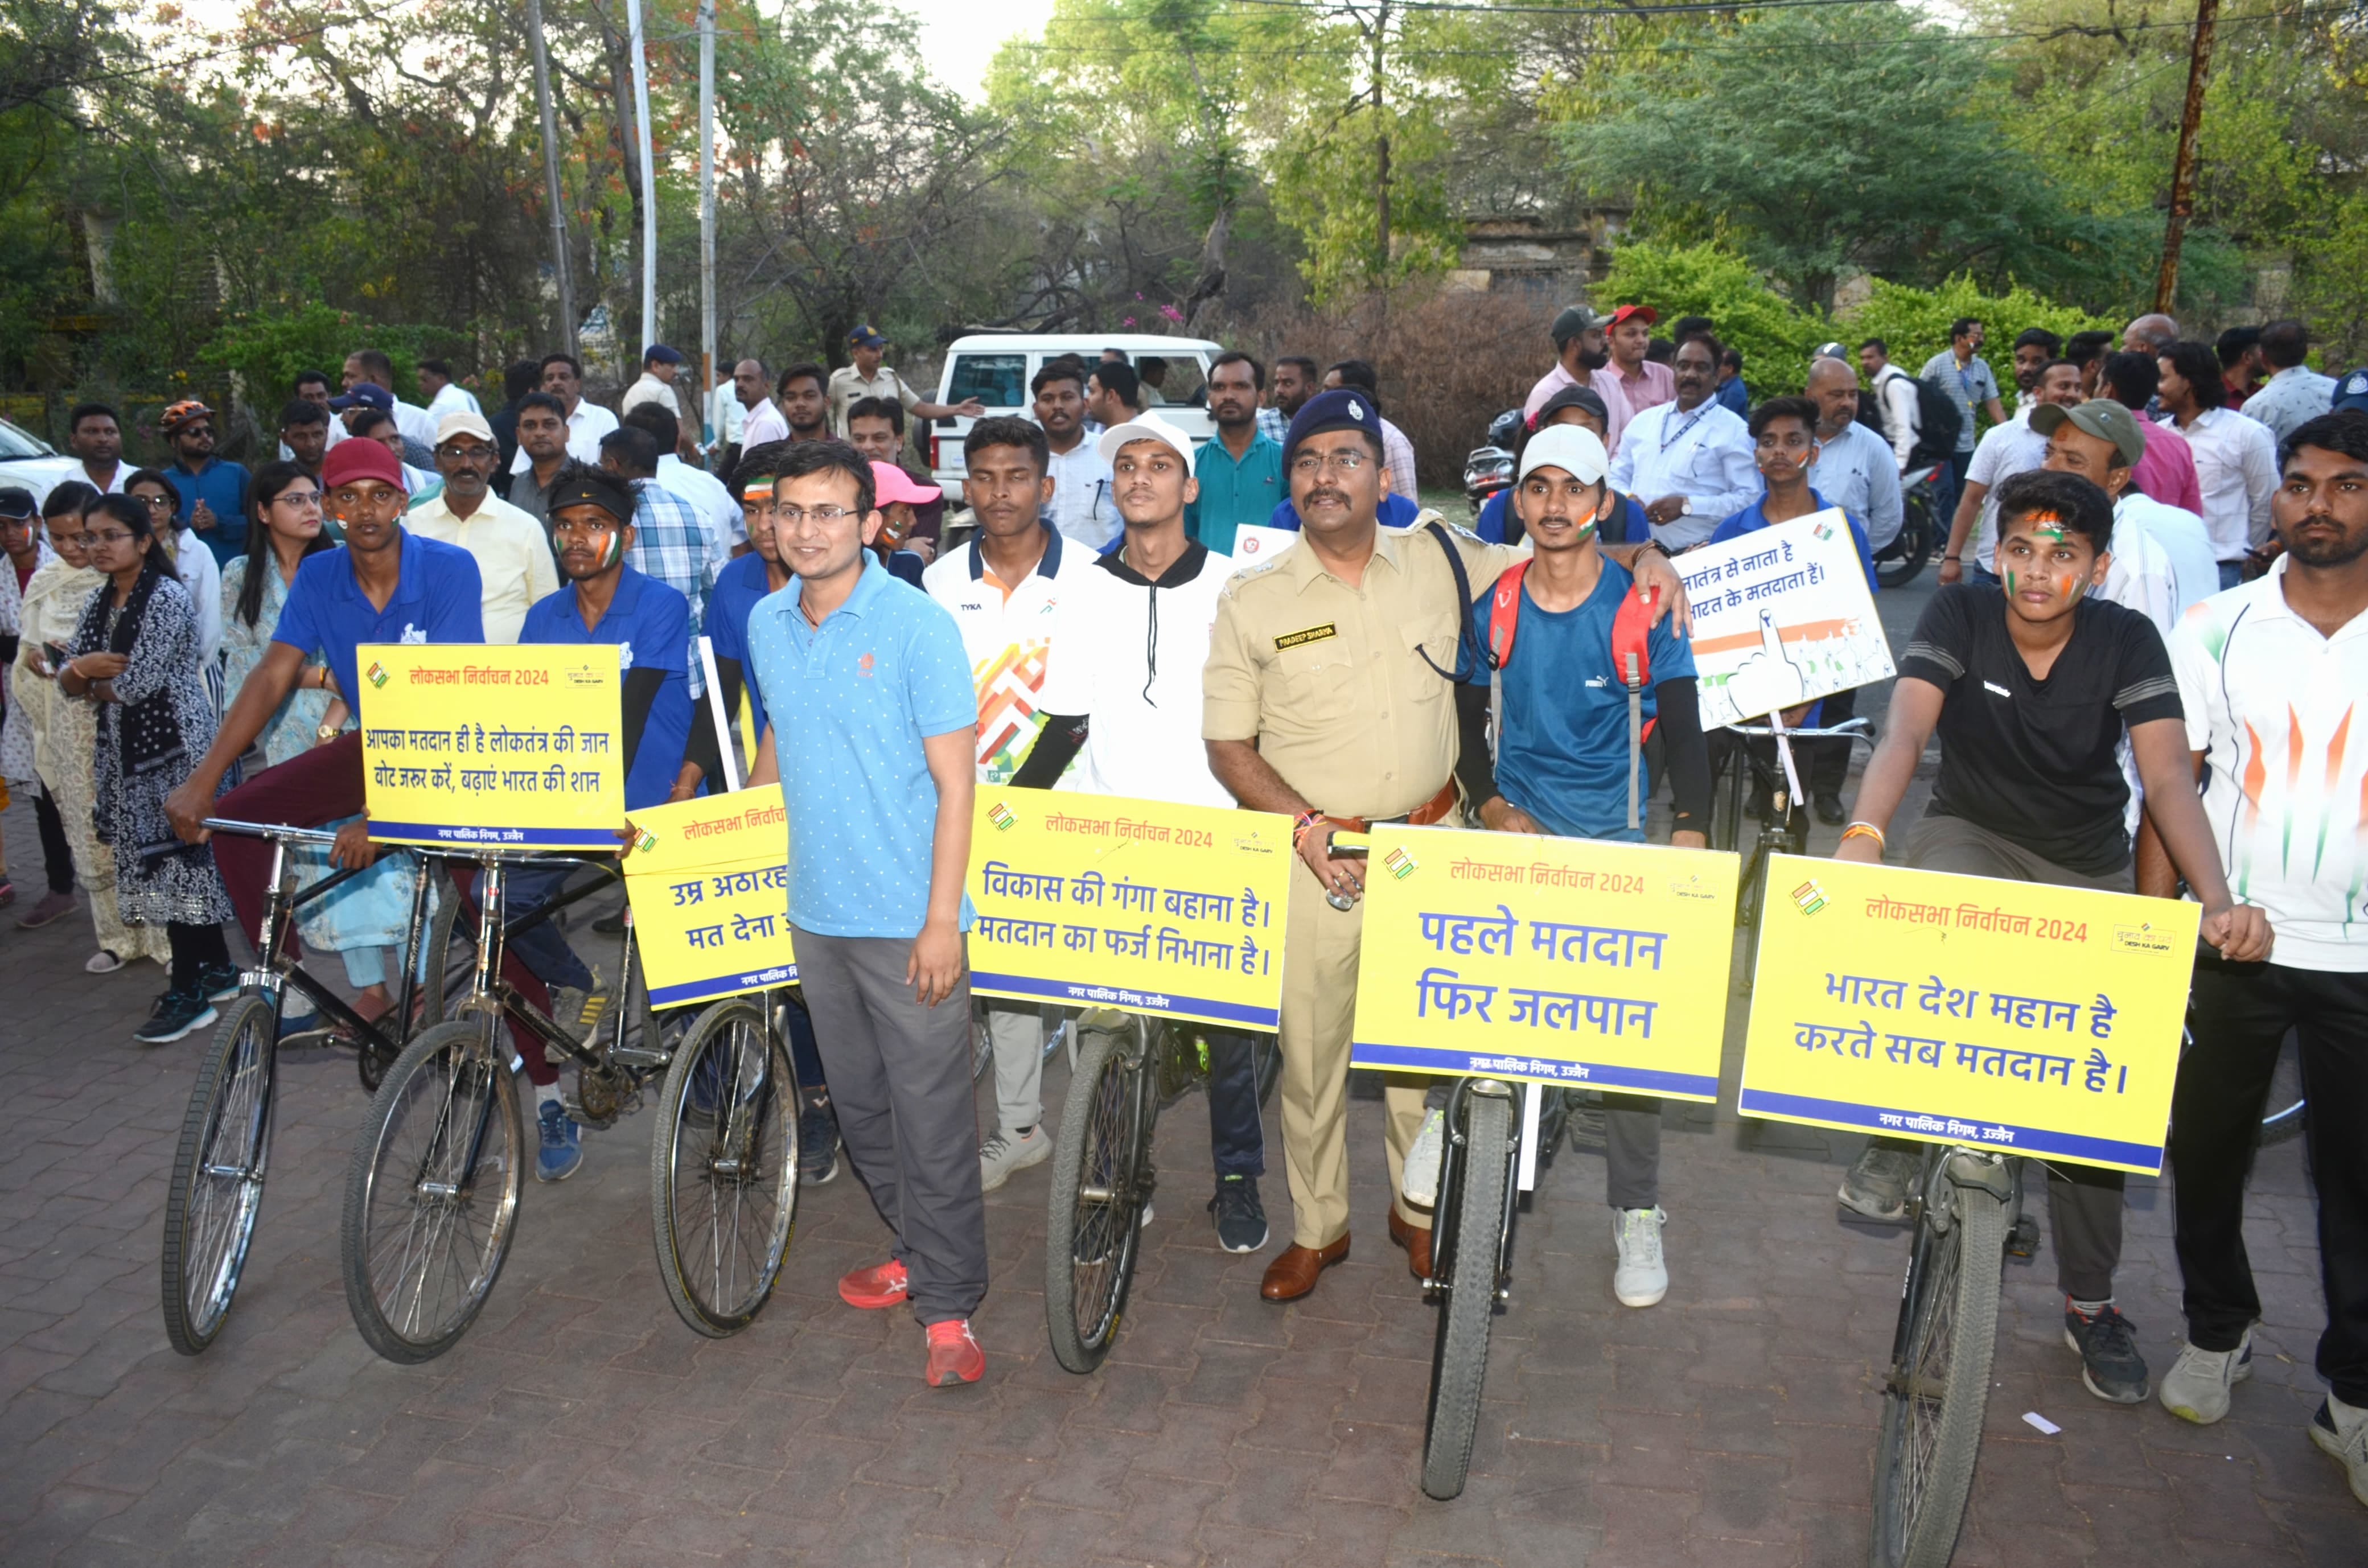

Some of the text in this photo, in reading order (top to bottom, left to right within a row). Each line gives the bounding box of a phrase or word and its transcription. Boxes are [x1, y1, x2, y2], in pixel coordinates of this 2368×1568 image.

[1724, 558, 1738, 577] से
[1741, 549, 1777, 570] नाता
[1782, 541, 1793, 561] है
[1725, 589, 1741, 606] के
[1745, 571, 1805, 600] मतदाता
[1278, 627, 1333, 647] PRADEEP SHARMA
[410, 666, 460, 685] लोकसभा
[463, 665, 511, 685] निर्वाचन
[515, 669, 549, 685] 2024
[366, 723, 610, 753] आपका मतदान ही है लोकतंत्र की जान
[374, 760, 396, 787] वोट
[431, 762, 455, 793] करें,
[460, 764, 497, 796] बढ़ाएं
[501, 771, 538, 791] भारत
[542, 764, 566, 791] की
[570, 771, 601, 792] शान
[453, 828, 478, 839] पालिक
[479, 829, 500, 841] निगम,
[502, 828, 524, 841] उज्जैन
[683, 805, 785, 840] लोकसभा निर्वाच
[1046, 812, 1212, 847] लोकसभा निर्वाचन 2024
[669, 880, 704, 906] उम्र
[982, 861, 1065, 902] विकास
[1070, 870, 1106, 907] की
[1112, 875, 1158, 913] गंगा
[1164, 888, 1234, 923] बहाना
[1451, 859, 1643, 893] लोकसभा निर्वाचन 2024
[685, 924, 724, 949] मत
[731, 913, 775, 941] देना
[1867, 894, 2087, 943] लोकसभा निर्वाचन 2024
[977, 915, 1056, 948] मतदान
[1063, 924, 1097, 953] का
[1104, 924, 1152, 959] फर्ज
[1156, 927, 1234, 970] निभाना
[1418, 903, 1669, 971] पहले मतदान
[741, 976, 758, 985] नगर
[759, 970, 787, 982] पालिक
[1068, 987, 1170, 1009] नगर पालिक निगम, उज्जैन
[1415, 966, 1659, 1039] फिर जलपान
[1826, 973, 2118, 1039] भारत देश महान है
[1493, 1057, 1529, 1073] पालिक
[1530, 1061, 1559, 1077] निगम,
[1560, 1063, 1590, 1080] उज्जैन
[1794, 1020, 1878, 1059] करते
[1885, 1034, 1947, 1068] सब
[1955, 1043, 2076, 1086] मतदान
[1879, 1113, 2015, 1144] नगर पालिक निगम, उज्जैन
